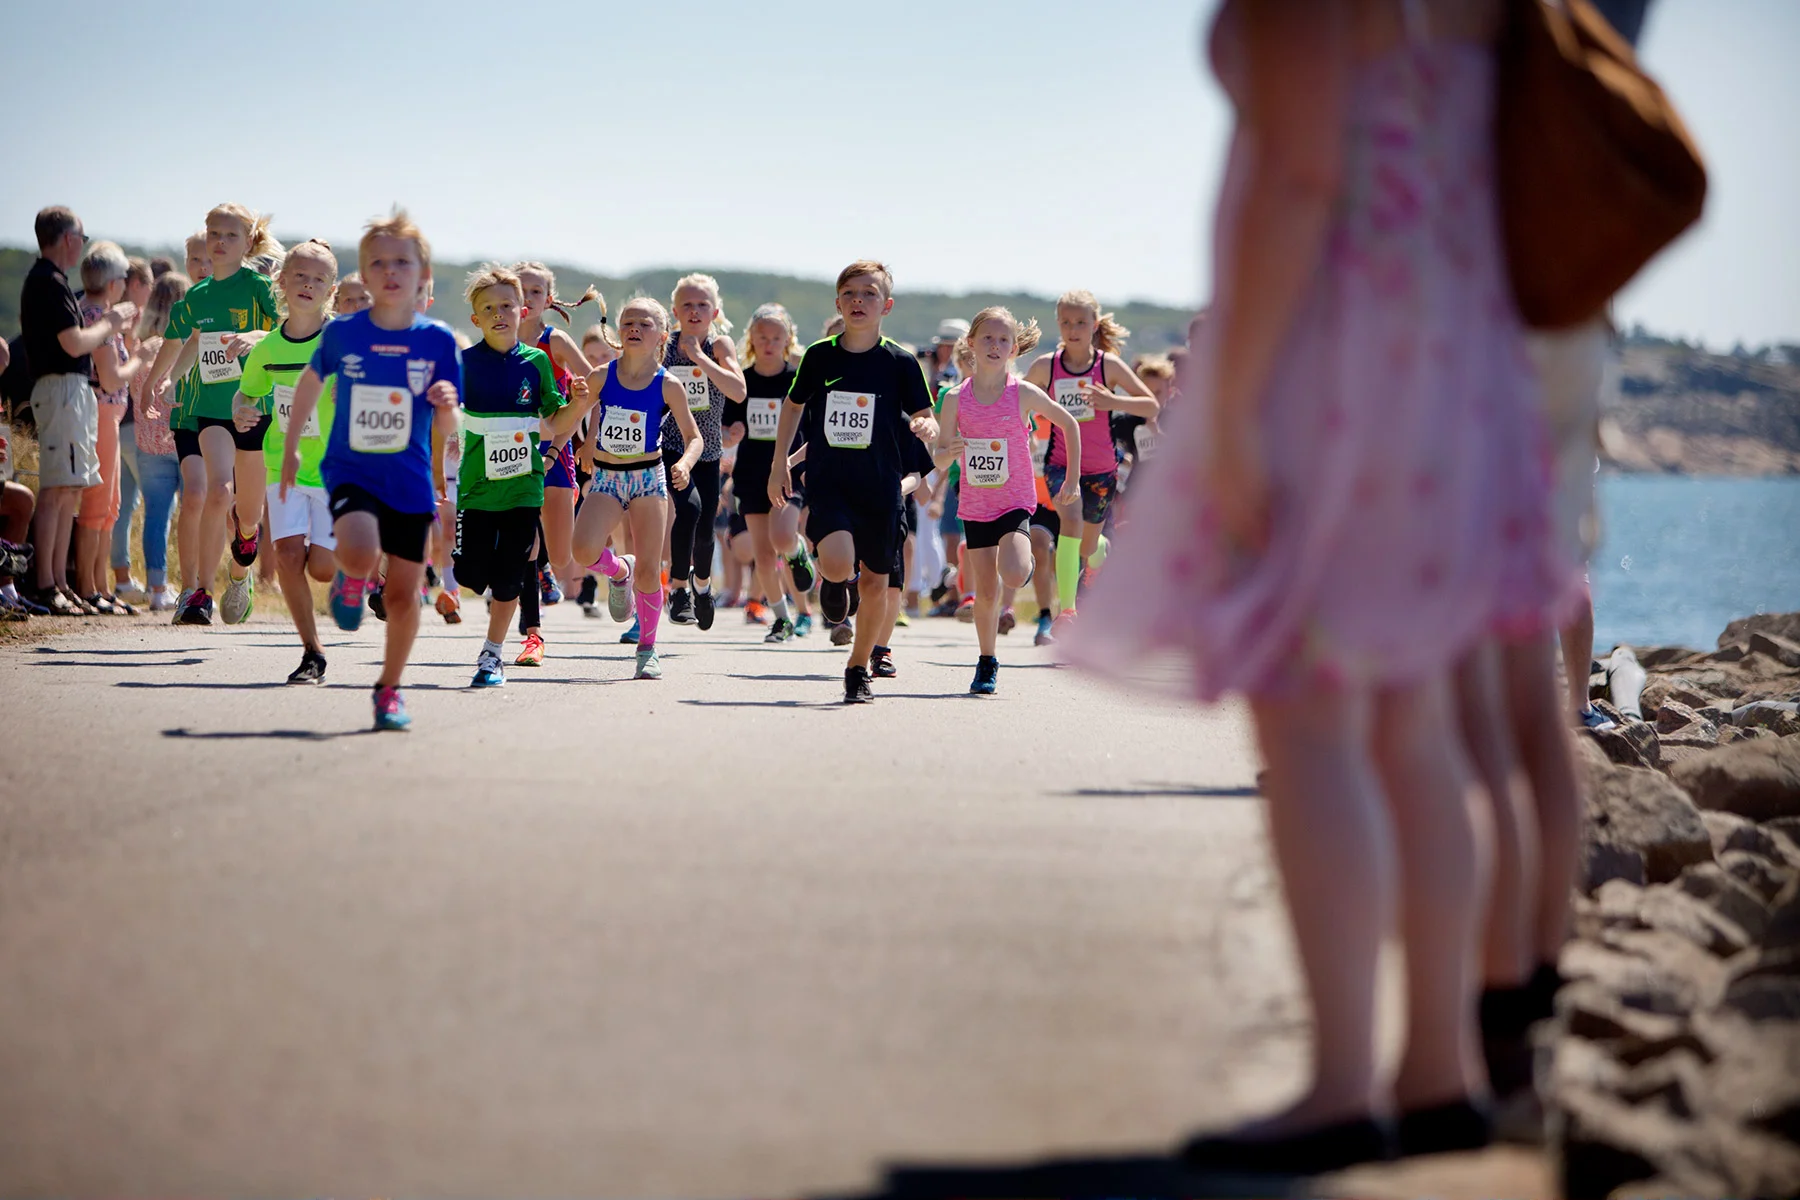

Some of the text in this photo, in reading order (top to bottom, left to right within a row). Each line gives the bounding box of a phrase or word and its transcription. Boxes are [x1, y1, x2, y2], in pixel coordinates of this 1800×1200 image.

[356, 410, 405, 430] 4006
[750, 413, 776, 425] 4111
[828, 410, 869, 429] 4185
[604, 425, 642, 442] 4218
[489, 446, 528, 463] 4009
[968, 455, 1004, 471] 4257
